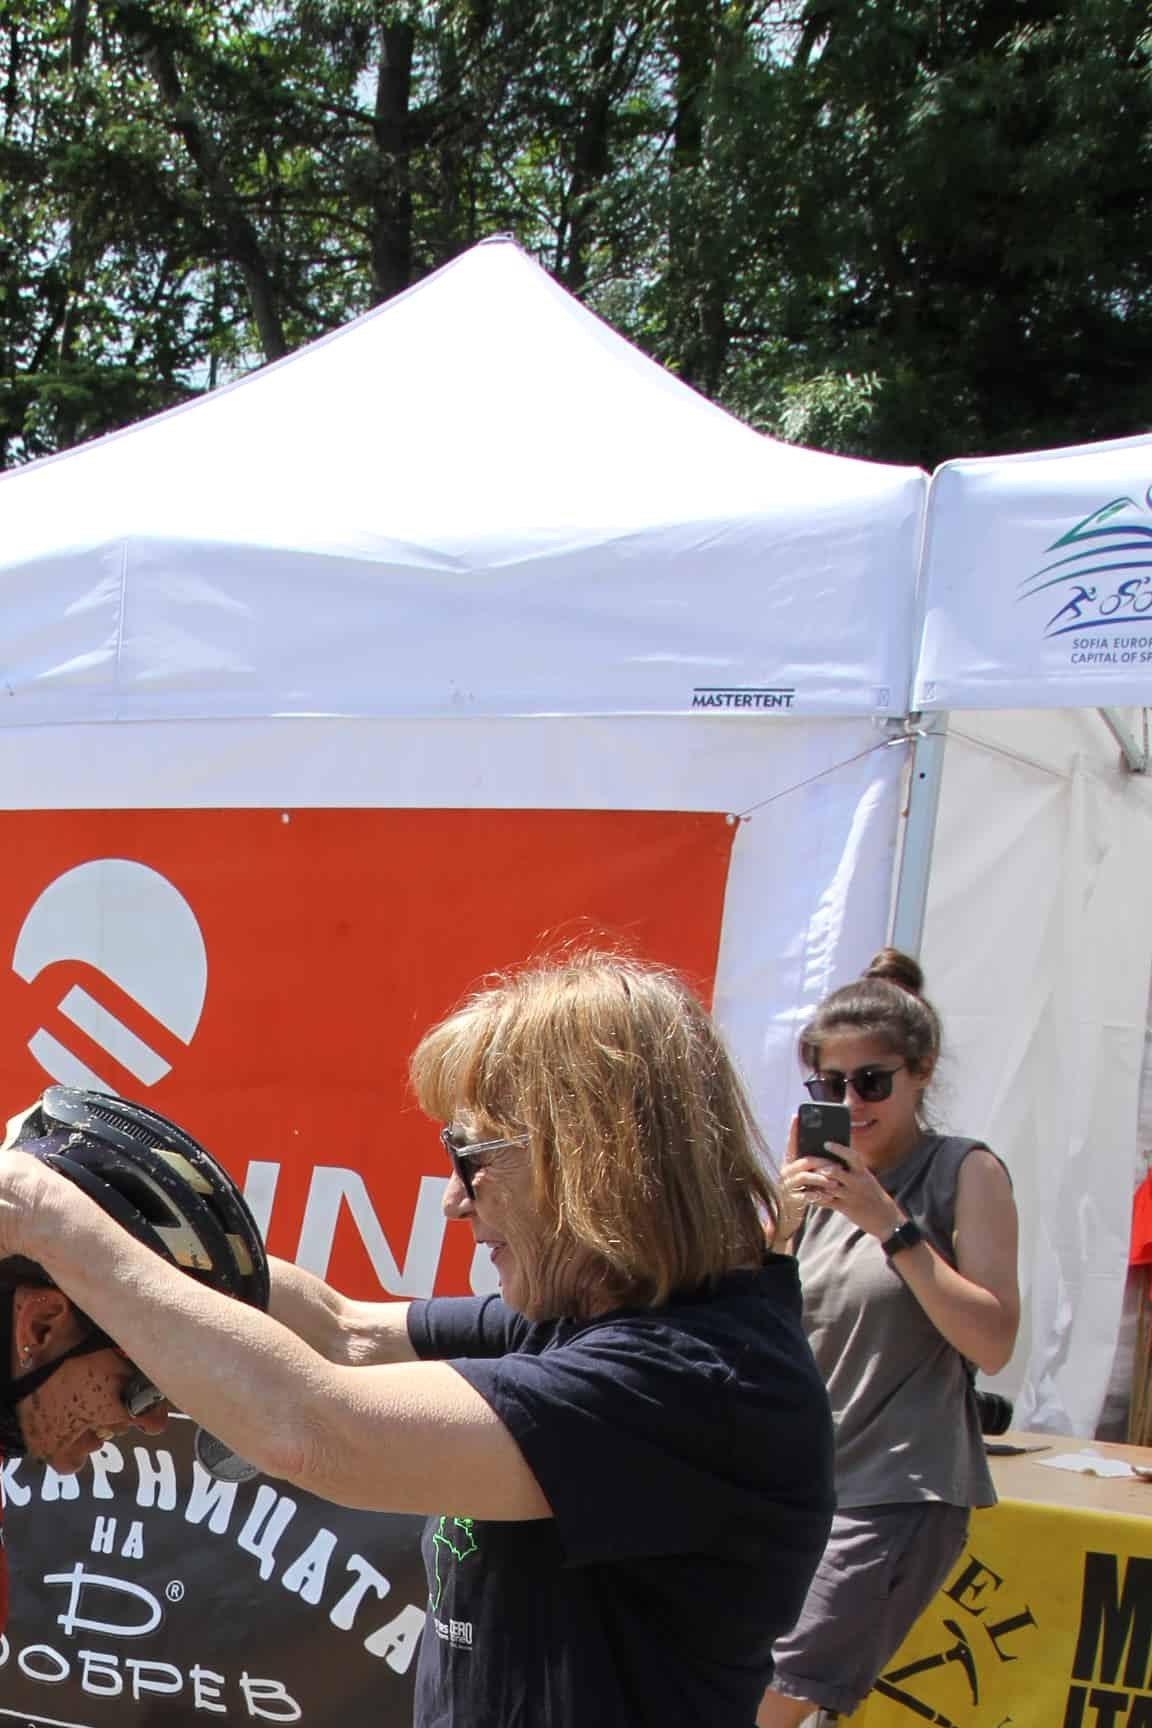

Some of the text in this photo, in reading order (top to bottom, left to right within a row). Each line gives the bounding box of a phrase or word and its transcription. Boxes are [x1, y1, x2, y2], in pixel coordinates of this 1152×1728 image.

[1072, 637, 1108, 649] SOFIA
[1071, 653, 1118, 664] CAPITAL
[1121, 652, 1137, 663] OF
[692, 694, 795, 708] MASTERTENT
[90, 1516, 145, 1560] НА
